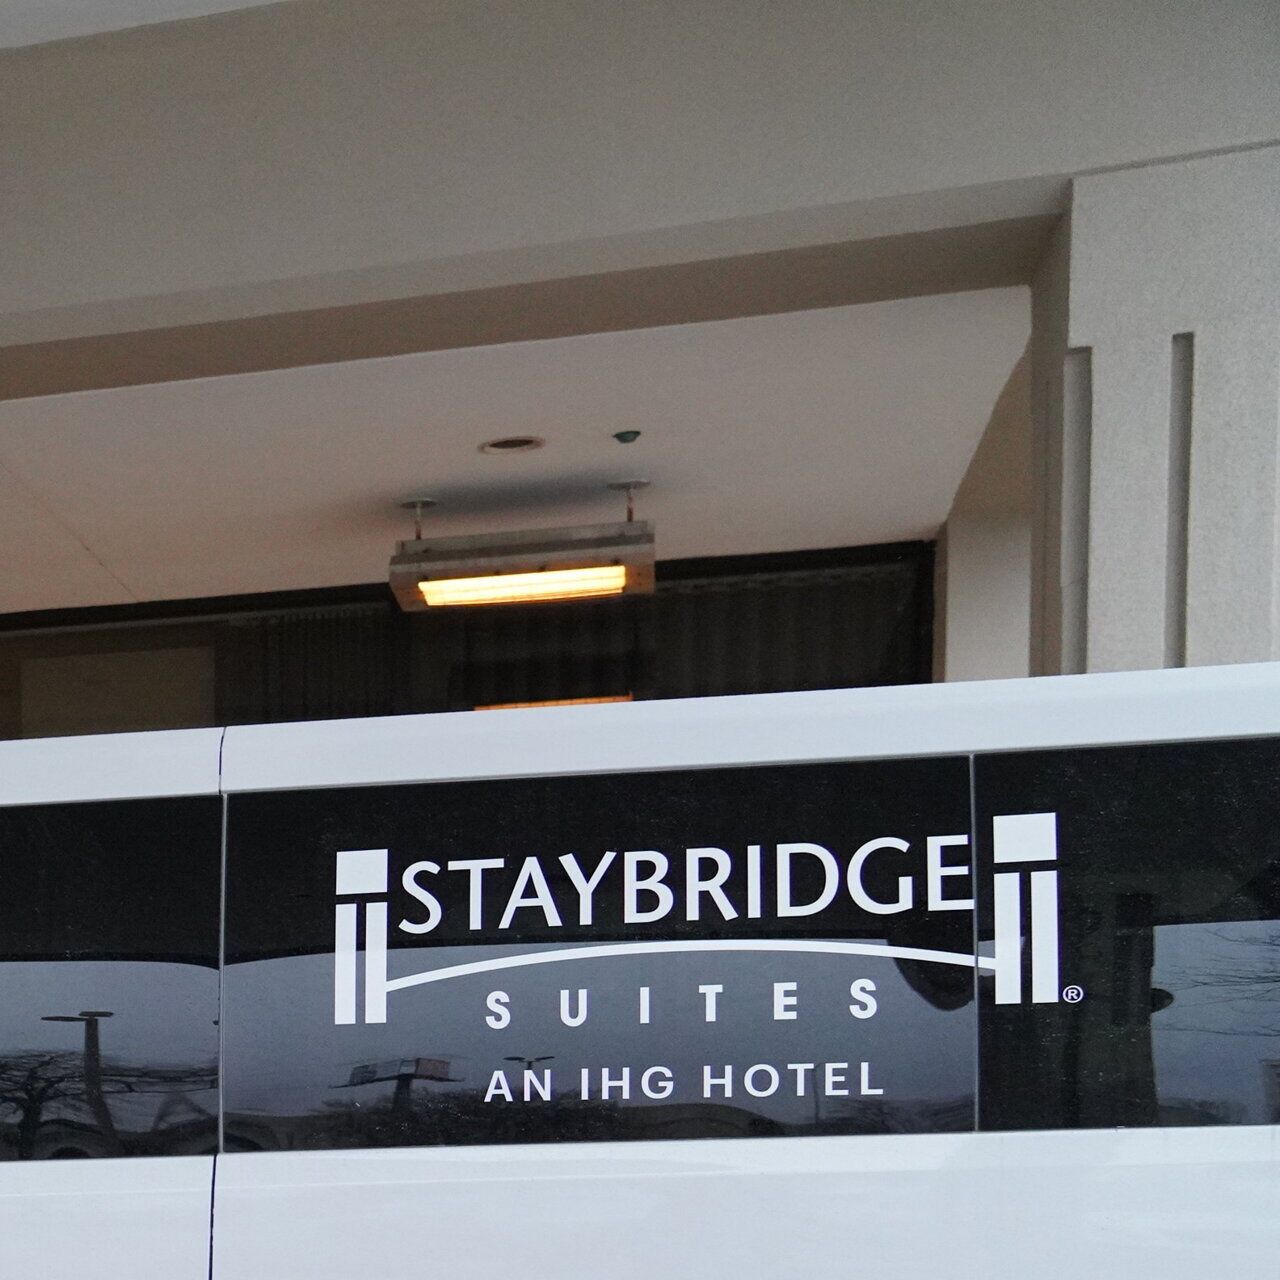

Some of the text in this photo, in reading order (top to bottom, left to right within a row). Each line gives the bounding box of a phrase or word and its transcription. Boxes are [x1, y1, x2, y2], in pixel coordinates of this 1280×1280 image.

[398, 834, 977, 934] STAYBRIDGE
[485, 978, 878, 1030] SUITES
[484, 1061, 884, 1103] AN IHG HOTEL
